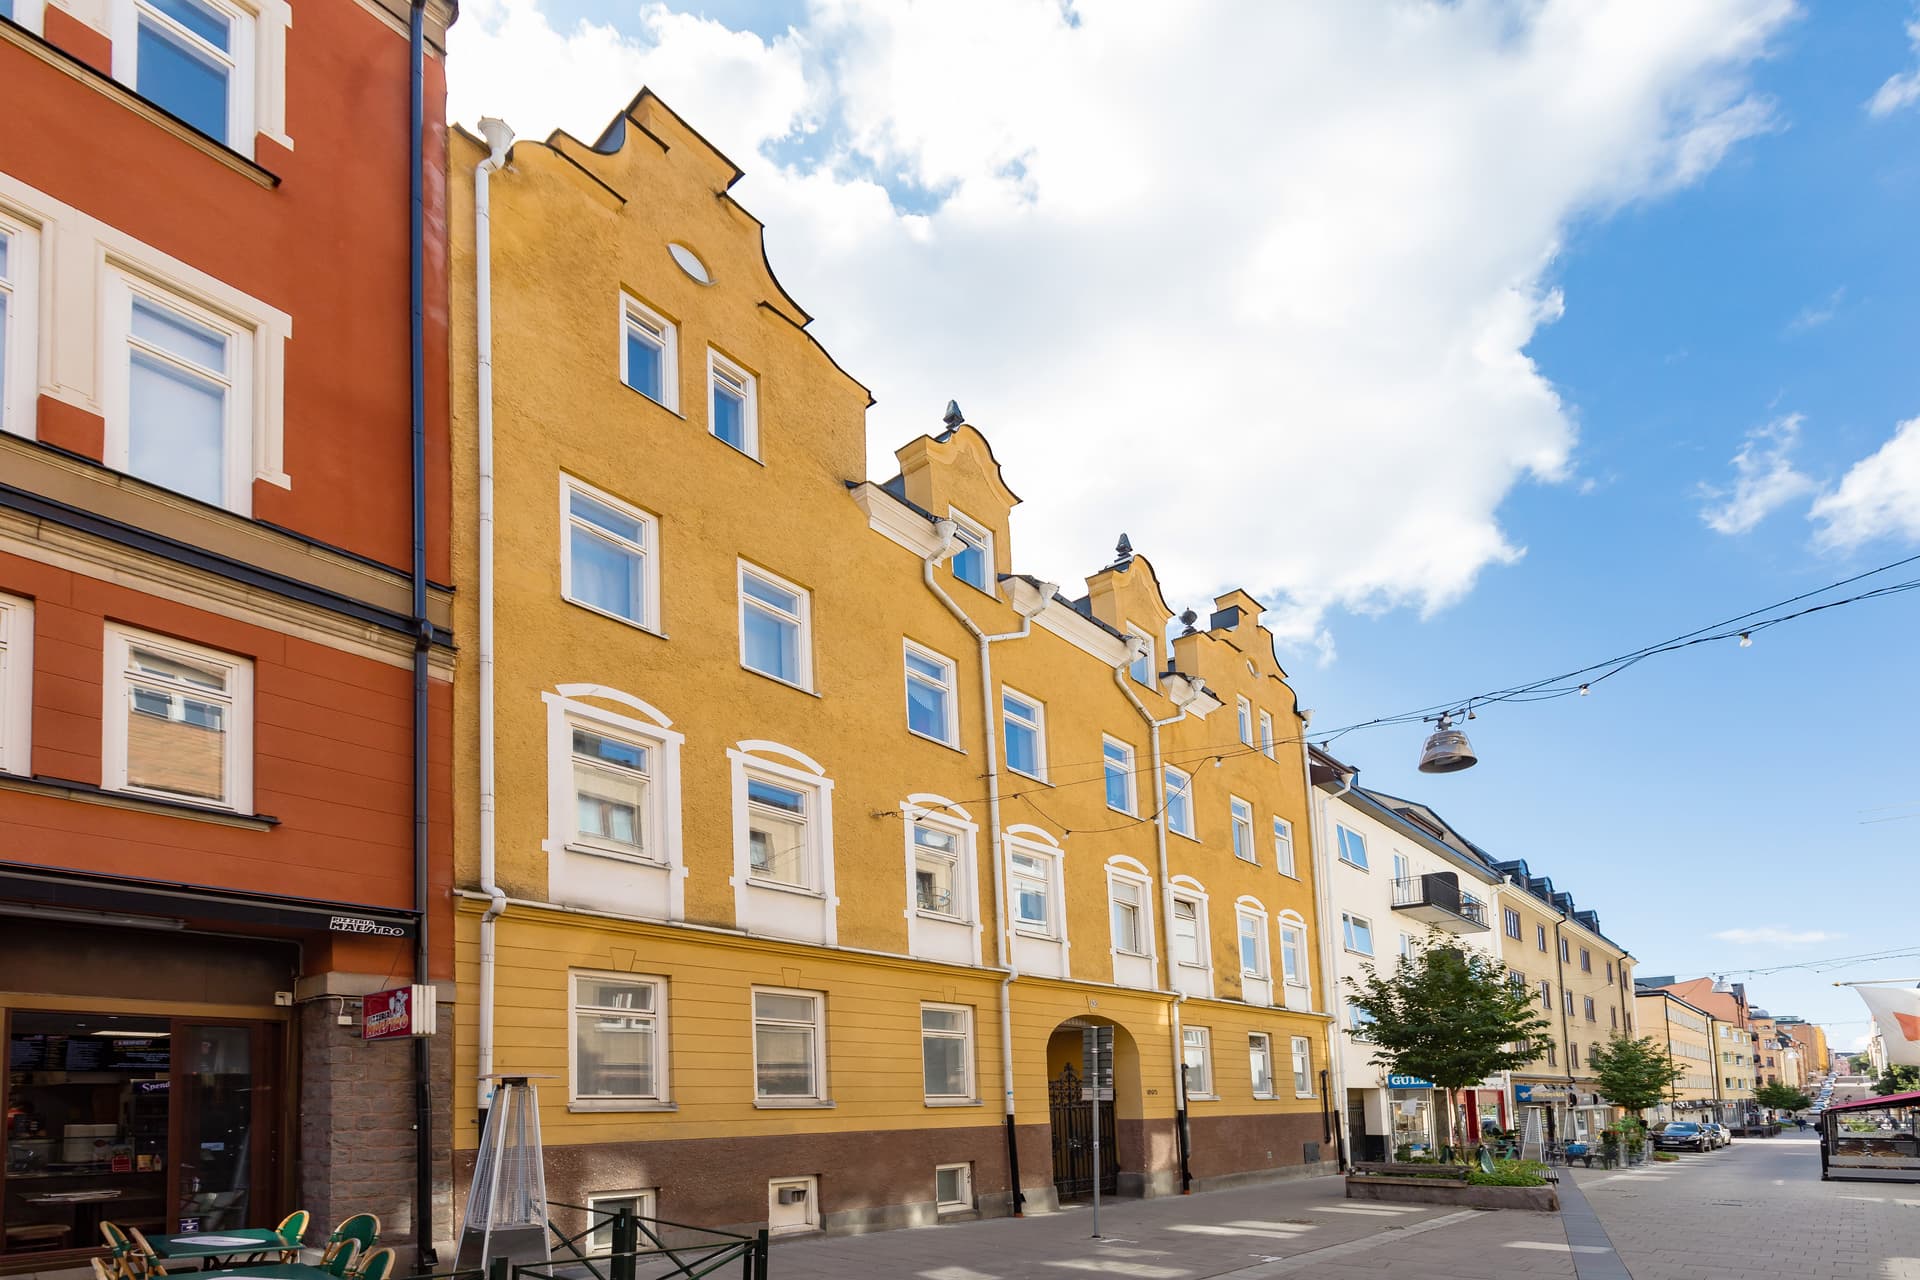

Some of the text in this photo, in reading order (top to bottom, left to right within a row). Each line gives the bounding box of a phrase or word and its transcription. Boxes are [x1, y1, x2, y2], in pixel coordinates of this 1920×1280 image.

[331, 916, 375, 926] PIZZERIA
[330, 922, 404, 936] MAESTRO
[366, 1015, 408, 1038] MAESTRO
